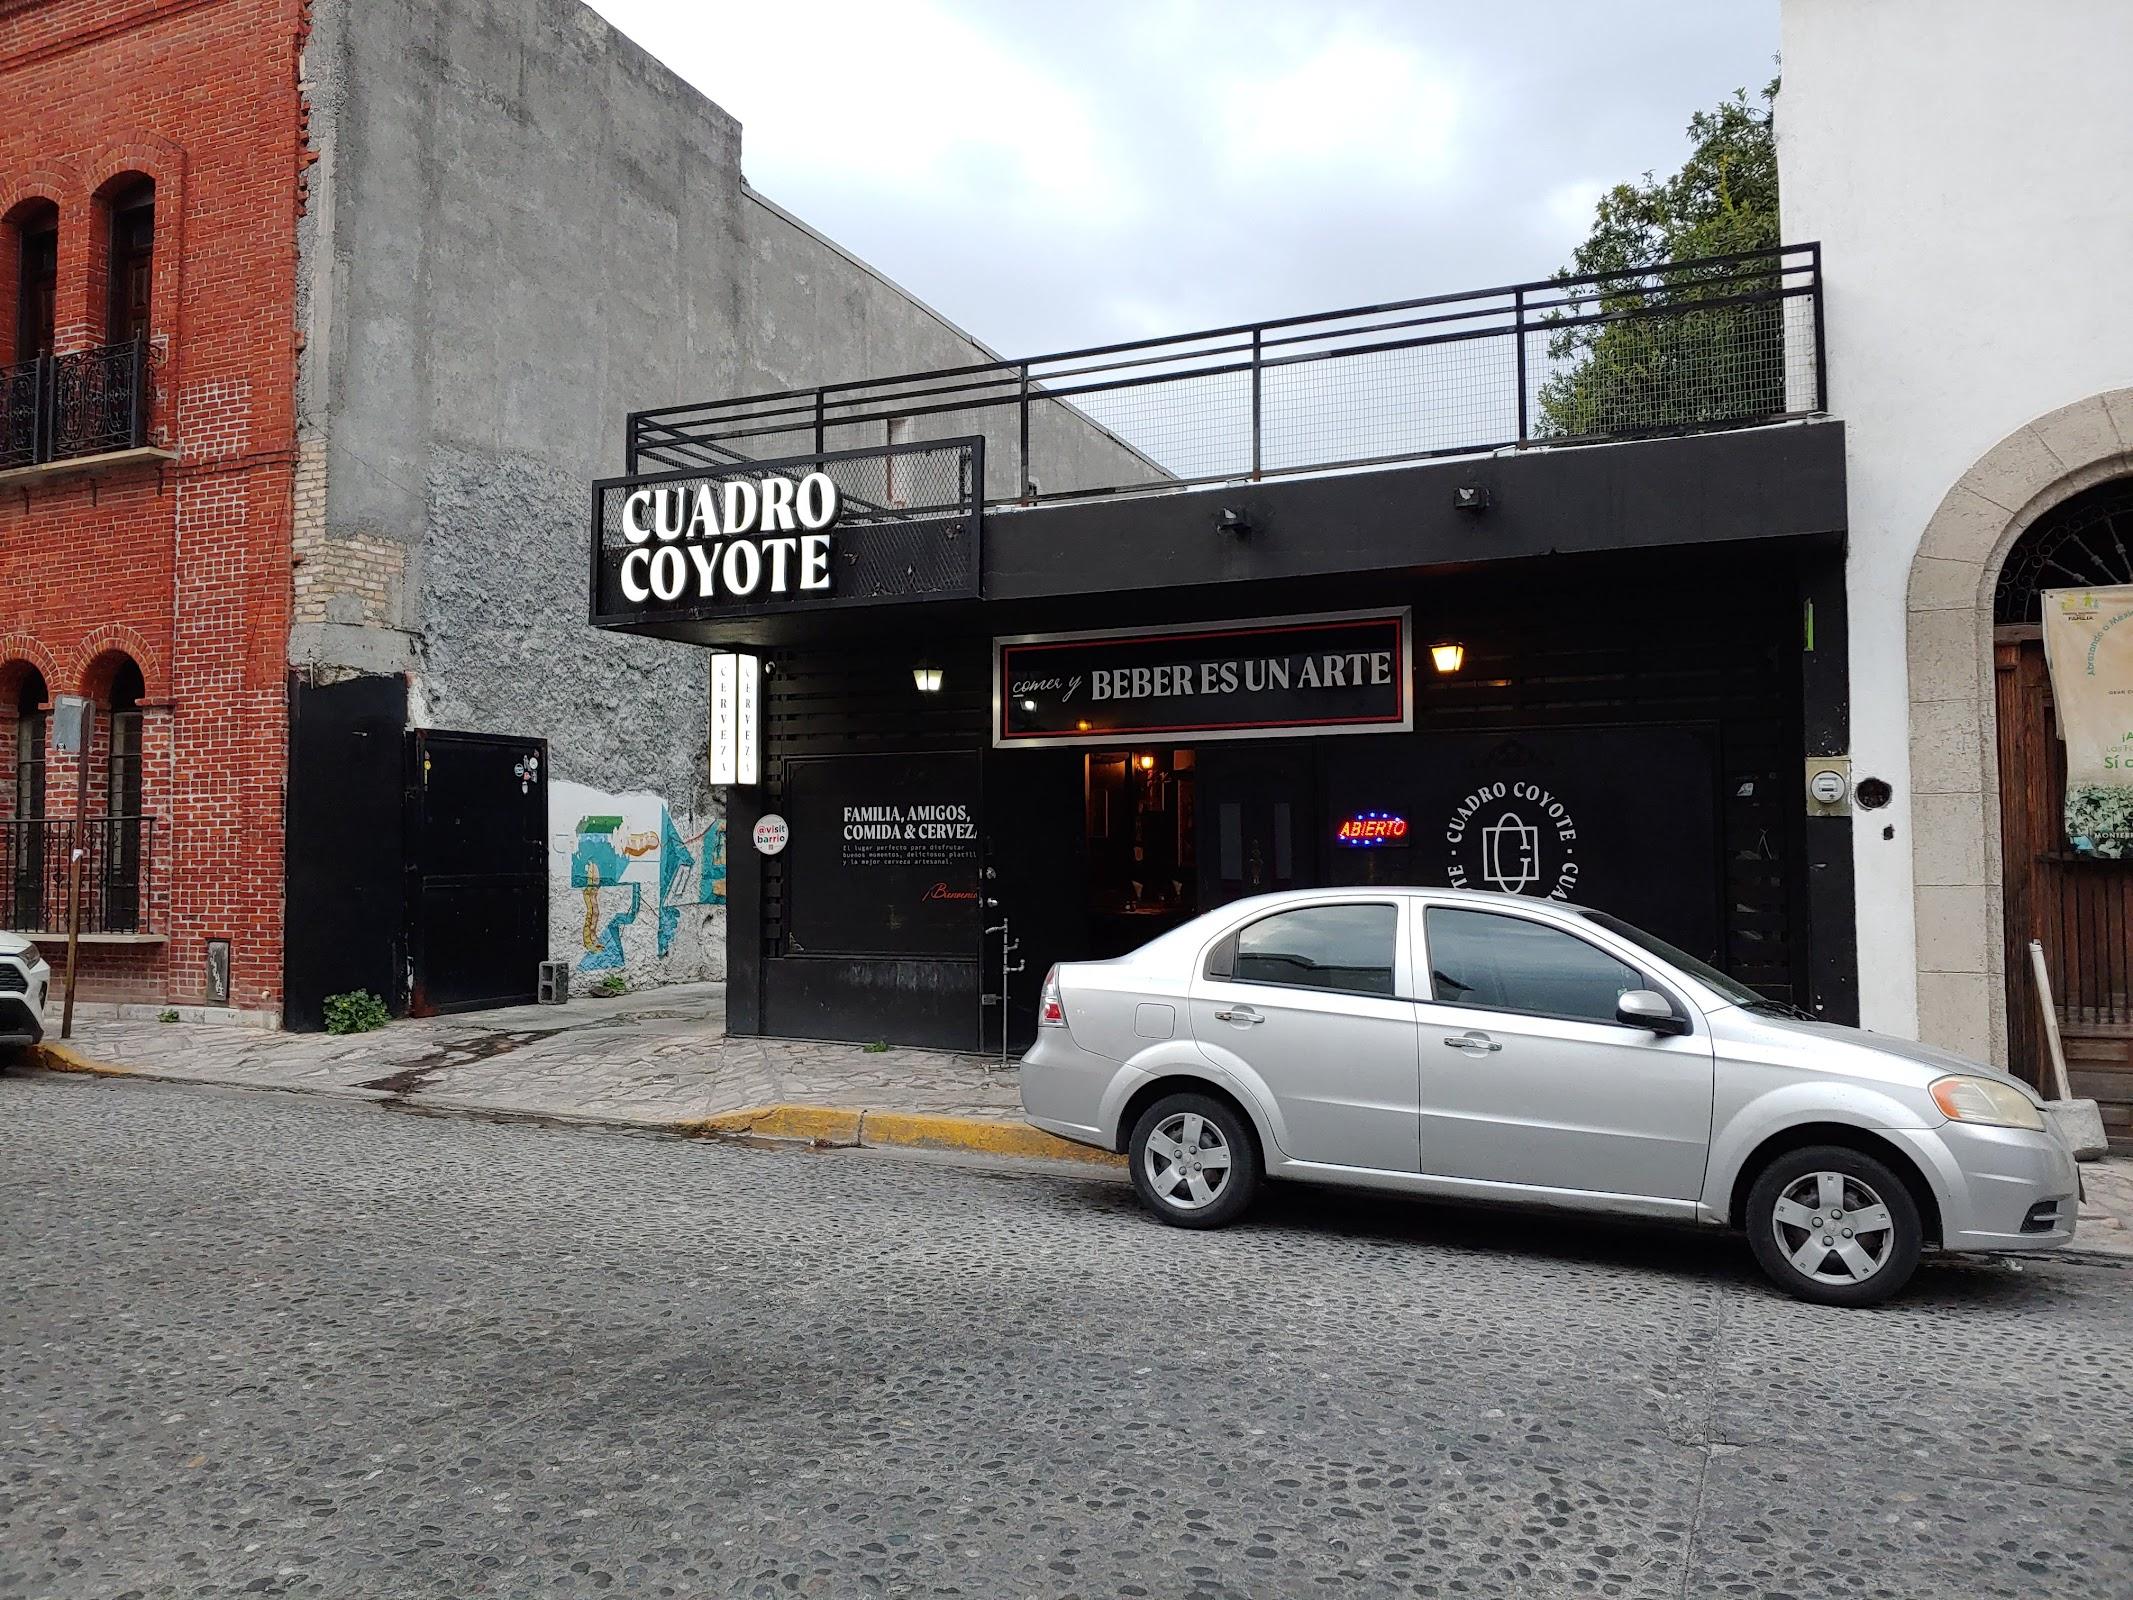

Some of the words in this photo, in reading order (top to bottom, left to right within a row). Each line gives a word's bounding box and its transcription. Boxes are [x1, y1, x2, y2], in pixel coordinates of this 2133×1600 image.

[622, 471, 836, 543] CUADRO
[620, 534, 832, 602] COYOTE
[1012, 676, 1062, 697] comer
[1062, 674, 1082, 702] y
[1091, 665, 1195, 701] BEBER
[1199, 661, 1239, 696] ES
[1245, 657, 1290, 692] UN
[1297, 651, 1392, 689] ARTE
[843, 806, 904, 823] FAMILIA,
[907, 805, 970, 822] AMIGOS,
[1446, 782, 1507, 843] CUADRO
[1513, 781, 1577, 842] COYOTE
[757, 825, 785, 835] @visit
[843, 824, 901, 840] COMIDA
[904, 824, 916, 839] &
[1340, 820, 1407, 837] ABIERTO
[757, 835, 785, 843] barrio
[876, 844, 907, 852] perfecto
[861, 858, 881, 866] mejor
[1549, 862, 1579, 900] CUA
